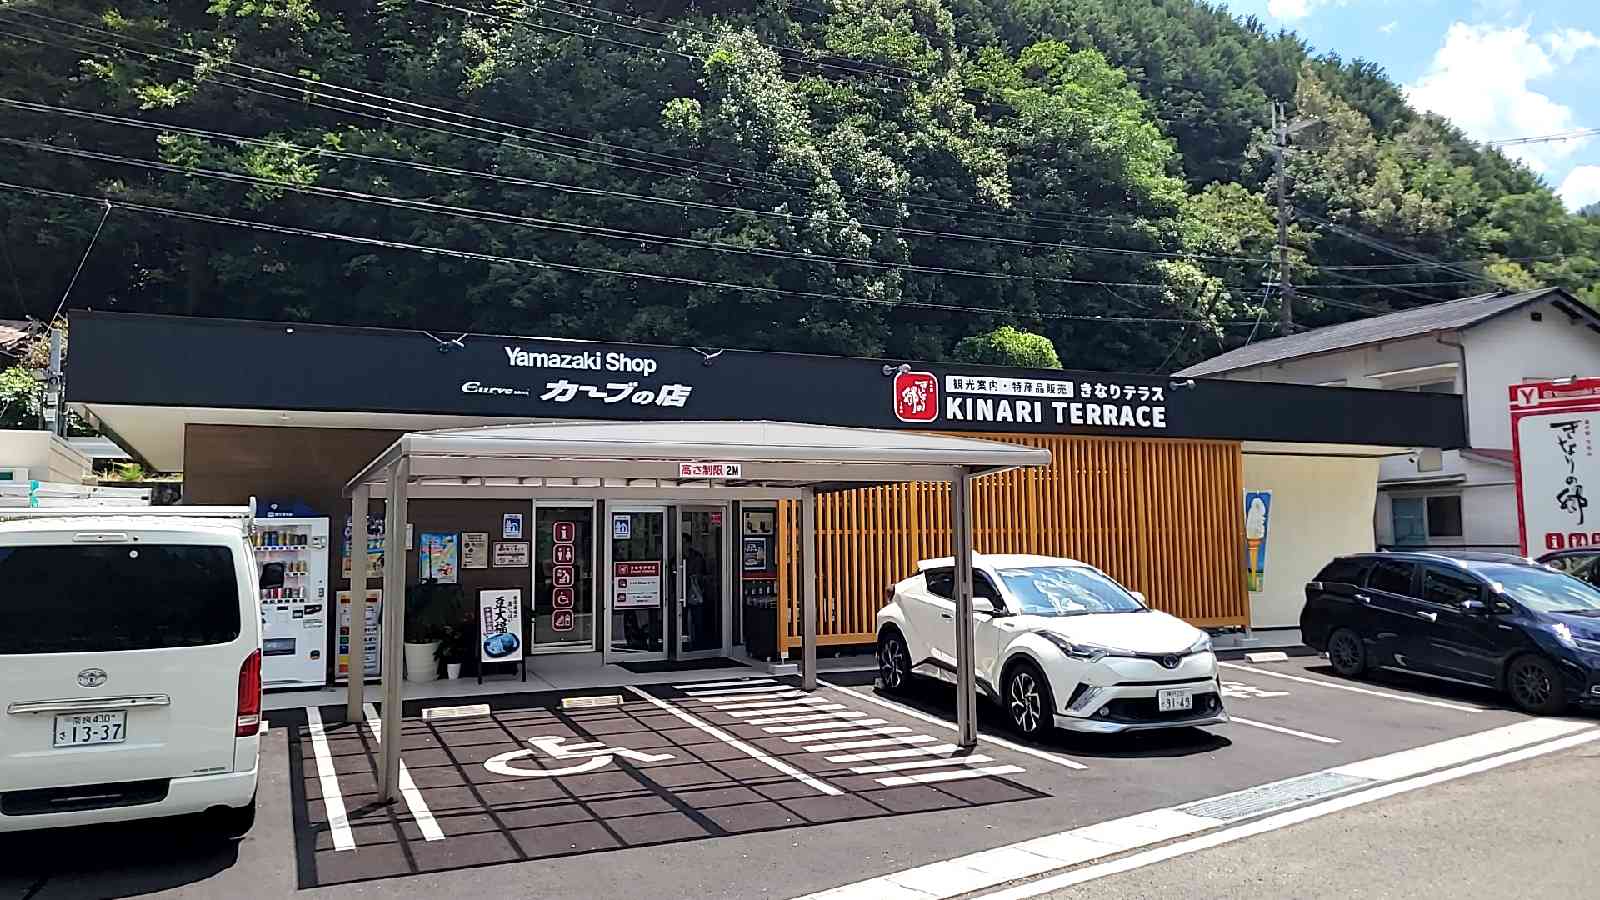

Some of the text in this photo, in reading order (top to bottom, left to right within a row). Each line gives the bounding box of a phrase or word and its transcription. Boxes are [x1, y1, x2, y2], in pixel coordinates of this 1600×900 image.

[505, 347, 657, 376] Yamazaki Shop
[952, 378, 1069, 396] 観光案内・特産品販売
[1080, 382, 1165, 402] きなりテラス
[946, 396, 1167, 428] KINARI TERRACE
[681, 464, 739, 476] 高さ制限 2M
[72, 723, 122, 743] 13-37
